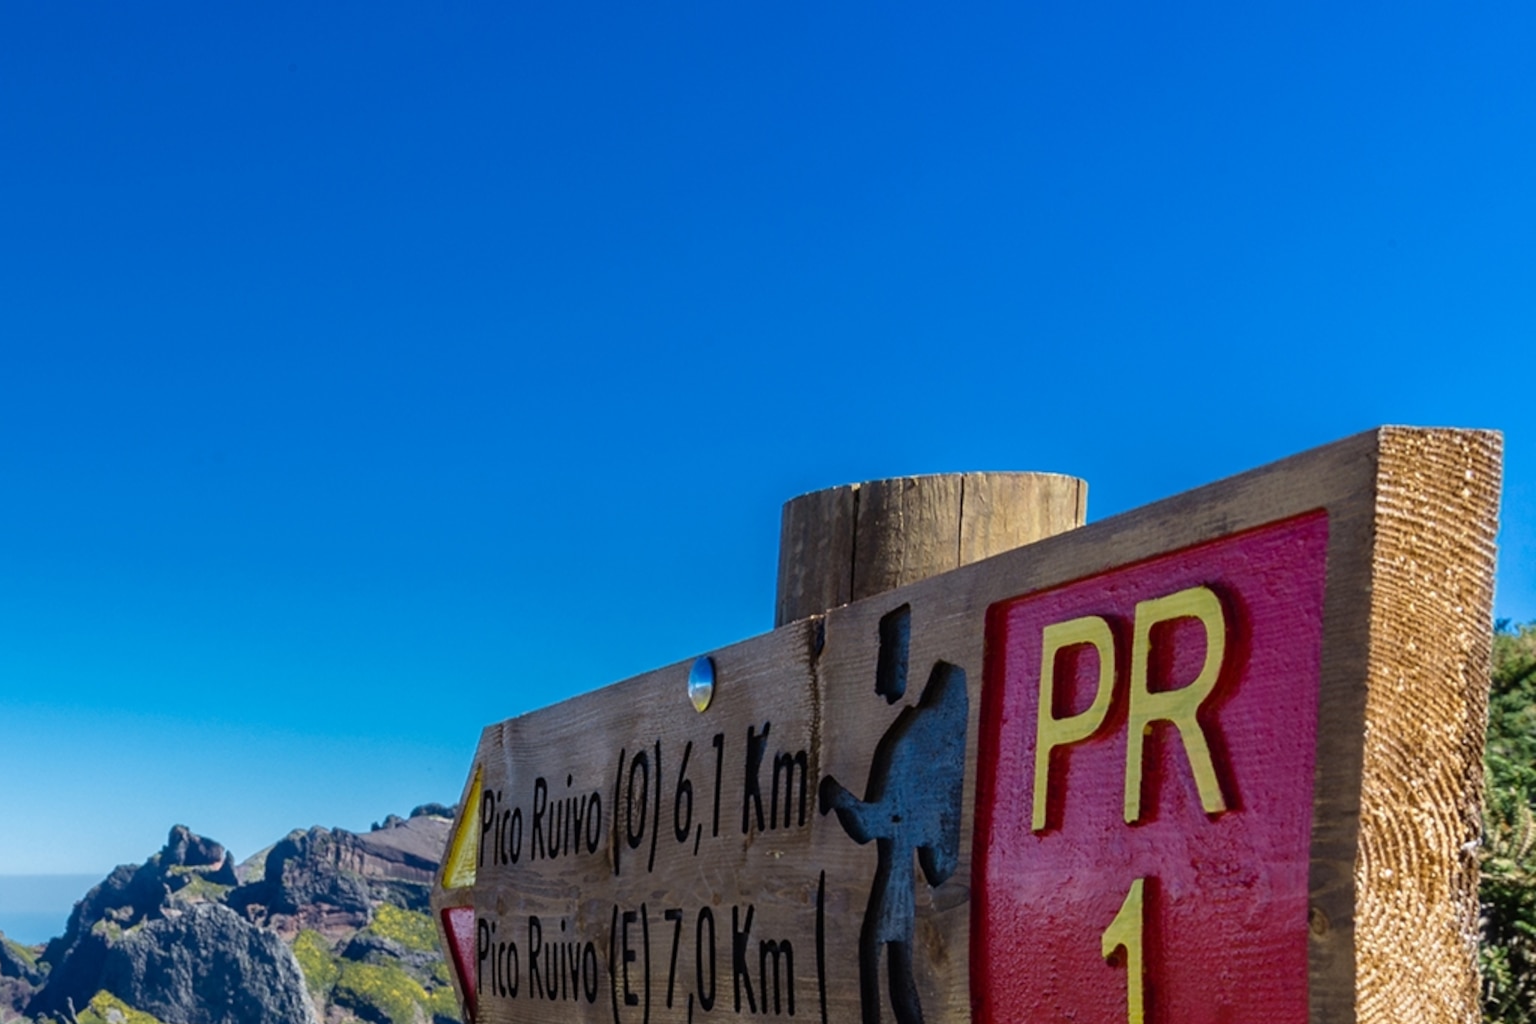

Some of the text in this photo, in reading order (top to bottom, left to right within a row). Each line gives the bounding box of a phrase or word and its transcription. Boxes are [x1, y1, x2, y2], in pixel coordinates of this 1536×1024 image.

[1031, 584, 1227, 832] PR
[479, 721, 808, 876] Pico Ruivo (O) 6,1 Km
[477, 917, 519, 999] Pico
[528, 914, 598, 1004] Ruivo
[732, 904, 795, 1016] Km
